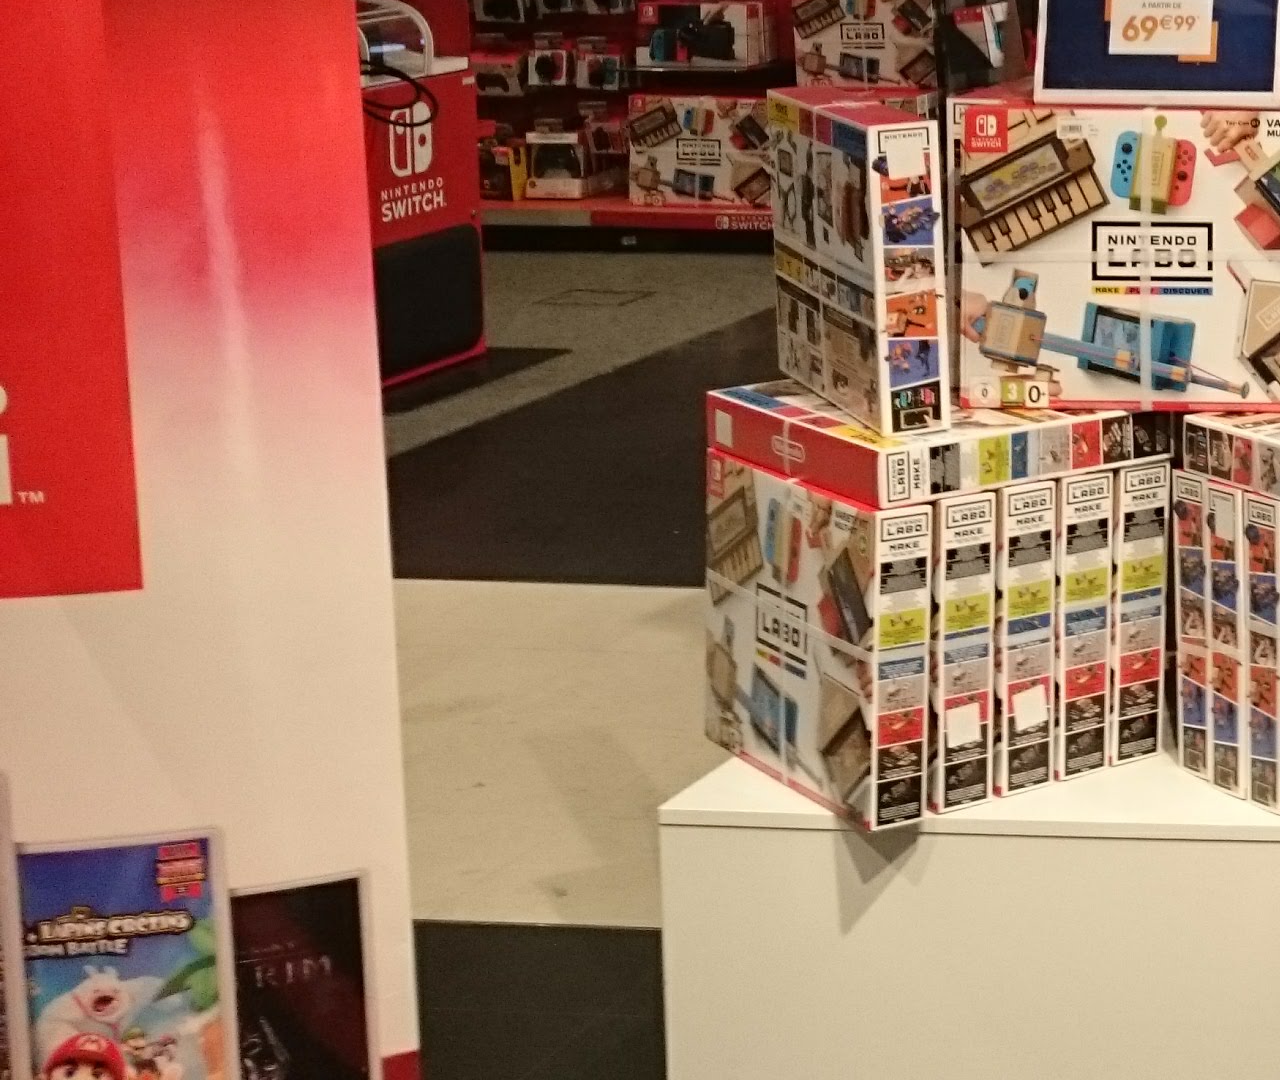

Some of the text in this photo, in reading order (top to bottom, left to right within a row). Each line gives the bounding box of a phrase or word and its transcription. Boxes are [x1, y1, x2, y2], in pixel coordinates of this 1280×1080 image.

[884, 131, 923, 140] NINTENDO
[381, 176, 443, 201] NINTENDO
[381, 189, 446, 223] SWITCH
[1107, 235, 1198, 246] NINTENDO
[1107, 248, 1198, 268] LABO
[1095, 286, 1210, 295] MAKE PLY DISCOVER
[896, 457, 906, 496] LABO
[913, 457, 921, 490] MAKE
[1129, 474, 1161, 487] LABO
[18, 490, 46, 505] TM
[1072, 486, 1105, 499] LABO
[1131, 490, 1160, 501] MAKE
[1180, 487, 1199, 497] LABO
[1013, 498, 1047, 511] LABO
[1073, 501, 1102, 513] MAKE
[951, 510, 986, 523] LABO
[1016, 514, 1045, 525] MAKE
[1252, 510, 1273, 522] LABO
[886, 523, 923, 536] LABO
[953, 526, 985, 537] MAKE
[888, 540, 921, 551] MAKE
[66, 938, 129, 955] BATTLE
